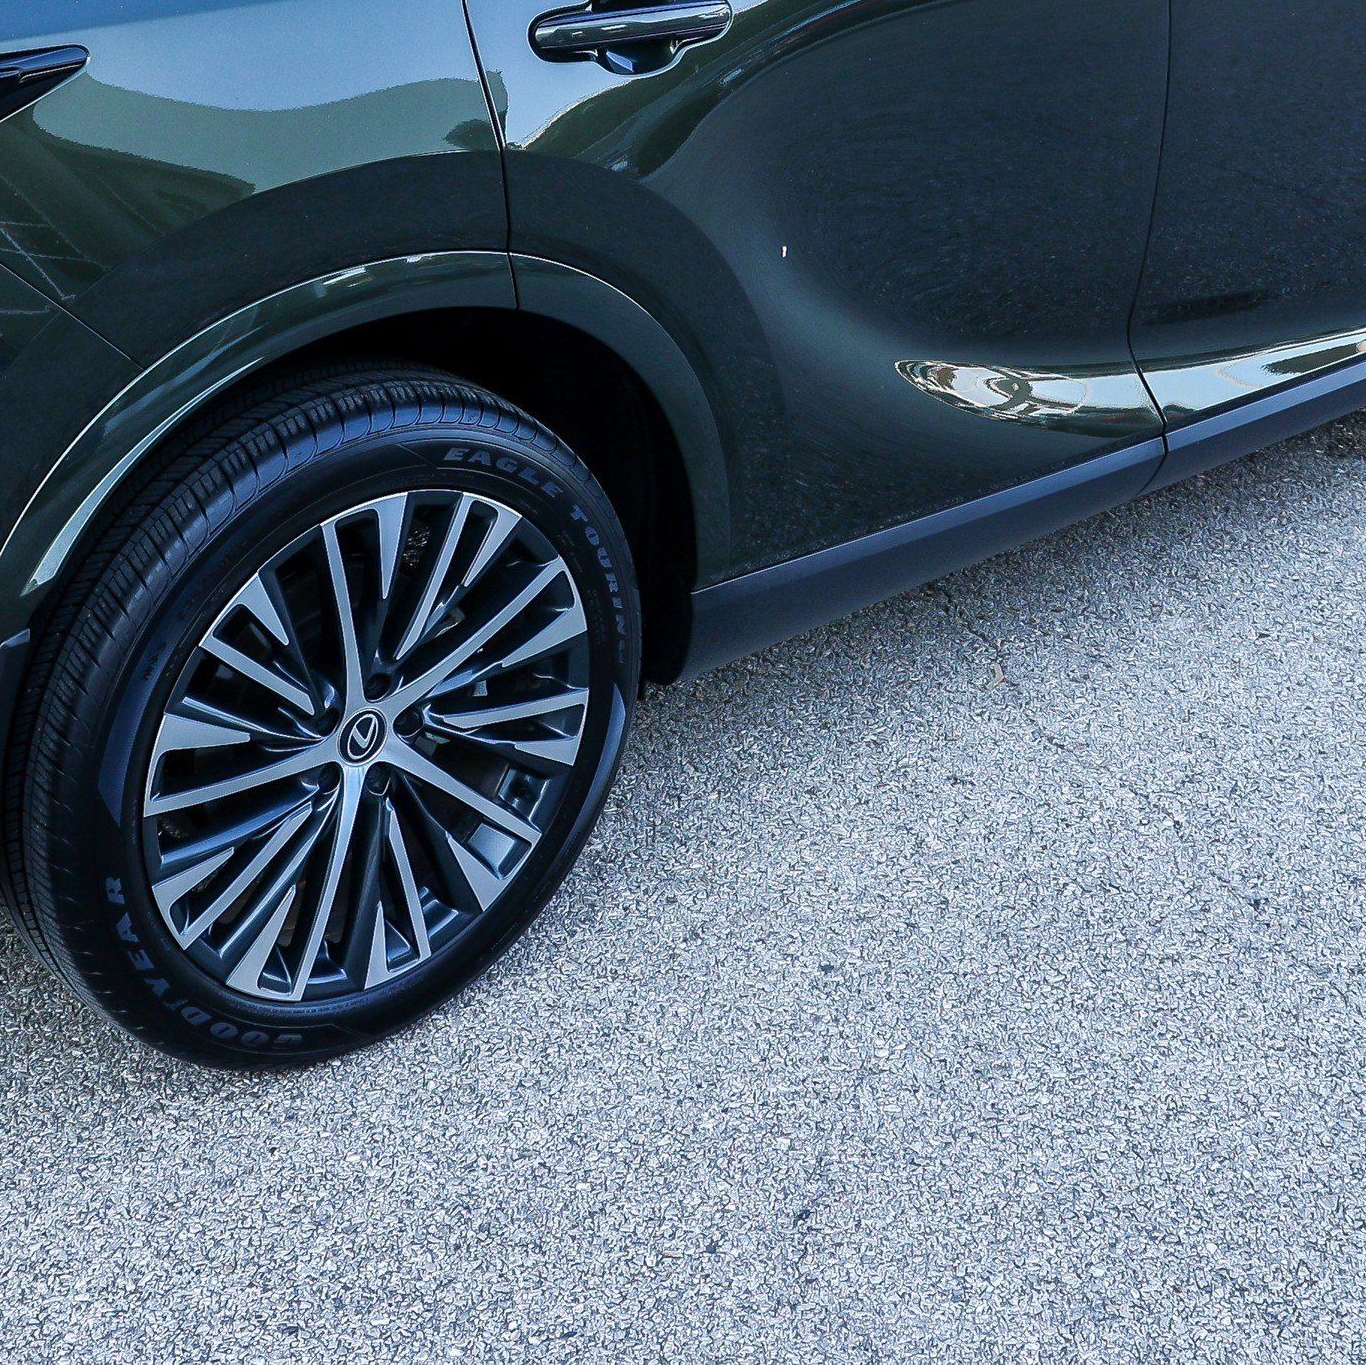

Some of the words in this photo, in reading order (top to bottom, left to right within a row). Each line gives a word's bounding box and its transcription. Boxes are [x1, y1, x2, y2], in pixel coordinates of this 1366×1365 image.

[443, 447, 563, 498] EAGLE
[570, 504, 628, 665] TOURING
[105, 876, 303, 1048] GOODYEAR
